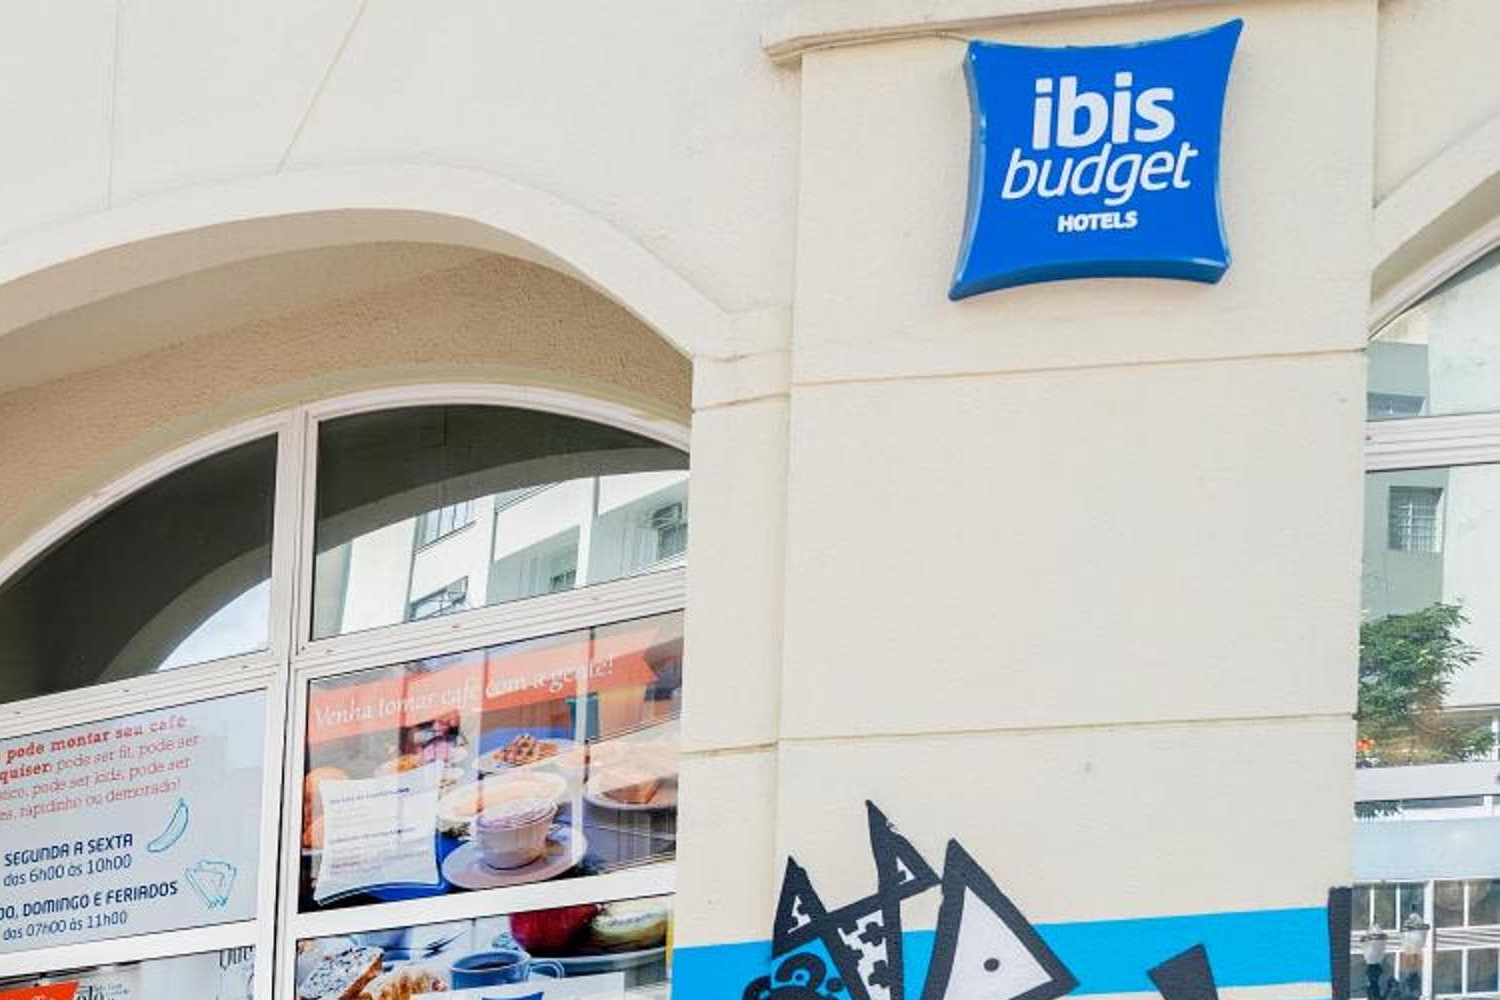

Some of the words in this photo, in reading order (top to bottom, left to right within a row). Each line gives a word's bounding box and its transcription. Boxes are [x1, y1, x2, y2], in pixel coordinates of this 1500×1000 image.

[1032, 71, 1176, 150] ibis
[1001, 141, 1198, 206] budget
[1057, 210, 1138, 233] HOTELS
[314, 698, 373, 726] Venha
[6, 742, 44, 764] pode
[51, 730, 111, 753] montar
[4, 843, 69, 867] SEGUNDA
[73, 841, 83, 856] A
[87, 833, 133, 854] SEXTA
[3, 871, 26, 887] das
[29, 865, 64, 882] 6h00
[87, 854, 133, 874] 10h00
[22, 893, 89, 917] DOMINGO
[93, 892, 102, 906] E
[105, 880, 178, 904] FERIADOS
[3, 925, 23, 940] das
[26, 920, 67, 937] 07h00
[87, 911, 127, 929] 11h00
